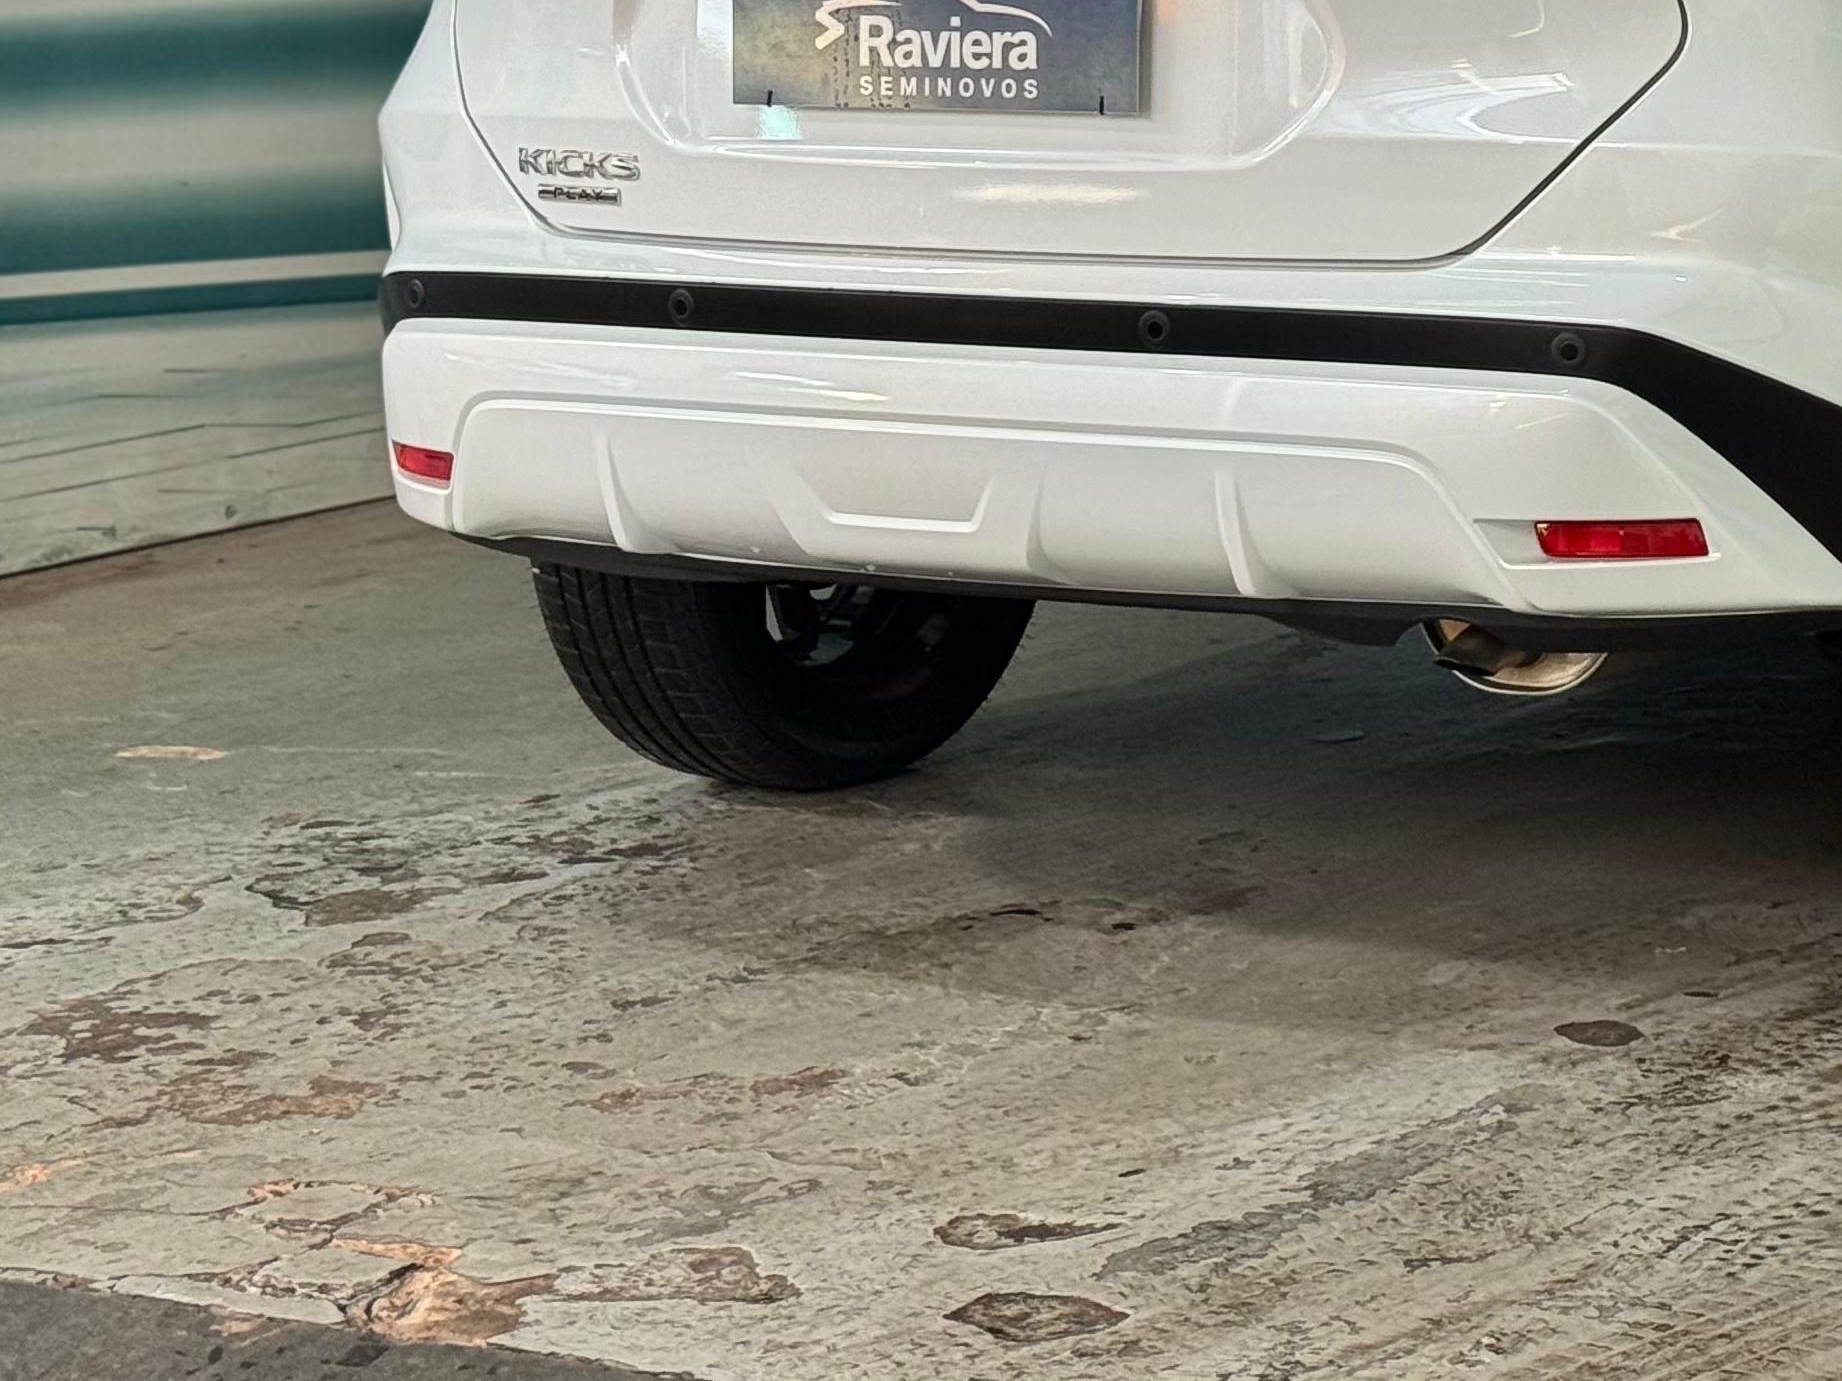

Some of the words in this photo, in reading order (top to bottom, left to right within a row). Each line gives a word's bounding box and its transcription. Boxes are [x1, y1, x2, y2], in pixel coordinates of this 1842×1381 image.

[858, 15, 1038, 71] Raviera
[859, 75, 1039, 99] SEMINOVOS
[518, 147, 641, 181] KICKS
